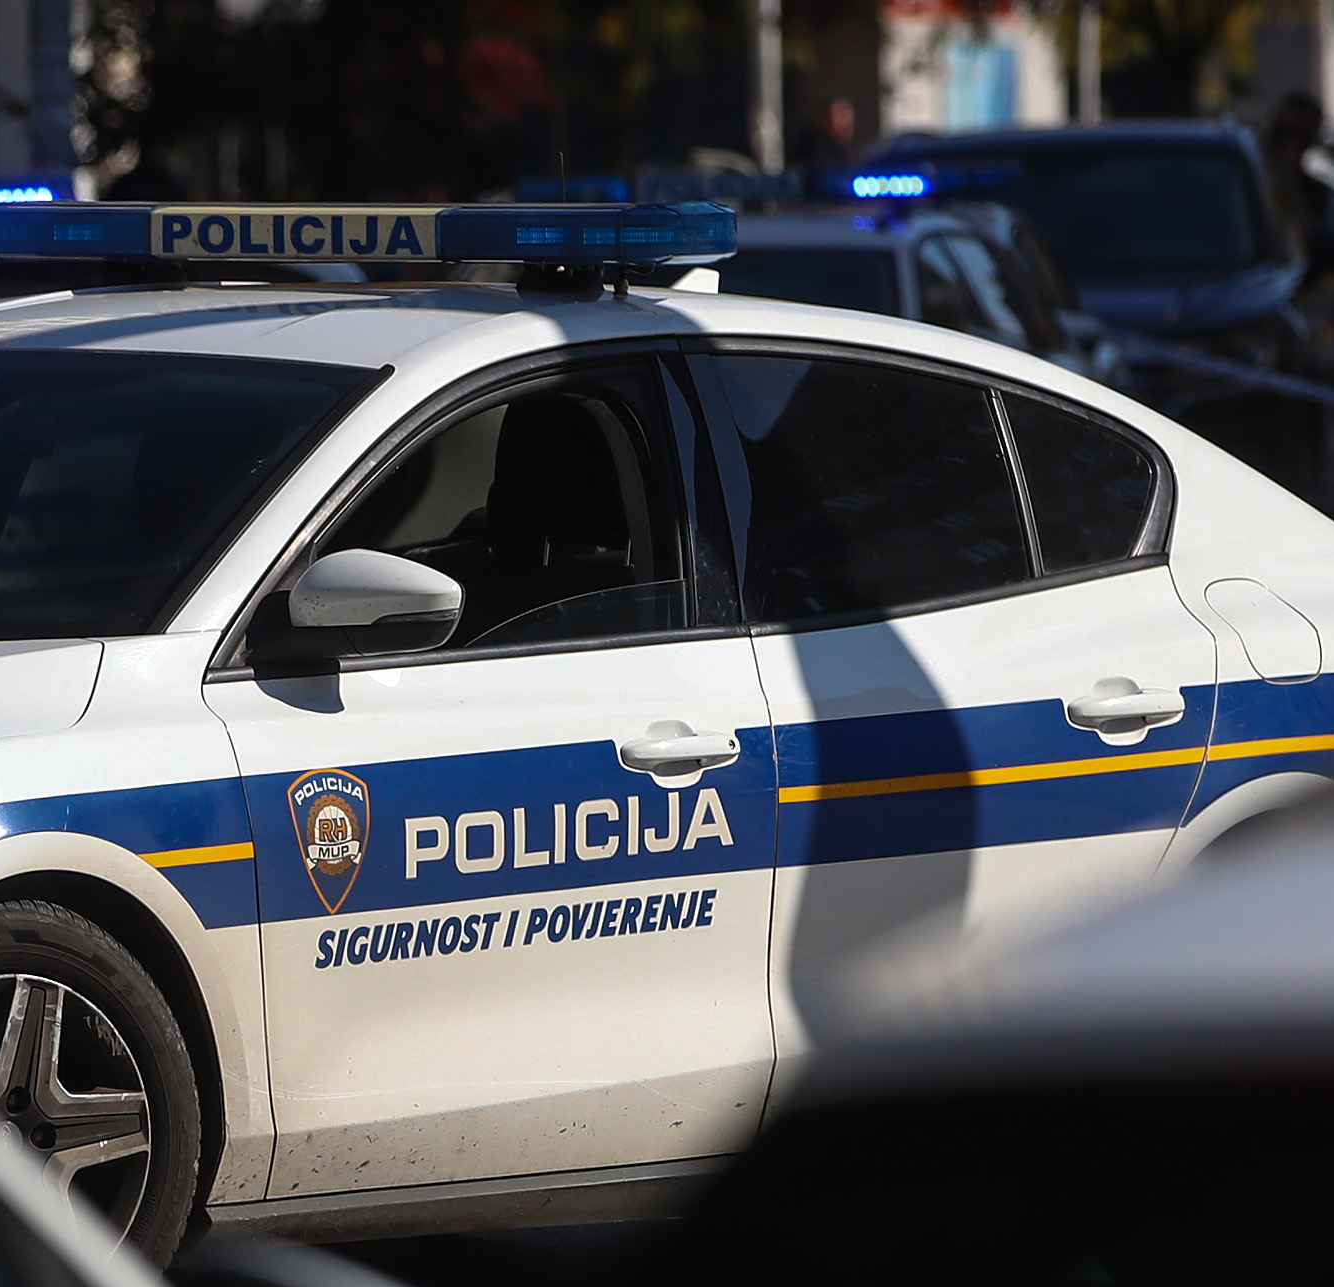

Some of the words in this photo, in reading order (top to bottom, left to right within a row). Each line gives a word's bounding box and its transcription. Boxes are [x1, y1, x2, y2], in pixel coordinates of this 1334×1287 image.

[161, 214, 423, 255] POLICIJA
[294, 777, 364, 806] POLICIJA
[318, 817, 348, 843] RH
[404, 787, 735, 880] POLICIJA
[318, 845, 350, 859] MUP
[314, 911, 502, 970] SIGURNOST
[502, 910, 520, 948] I
[523, 888, 718, 946] POVJERENJE
